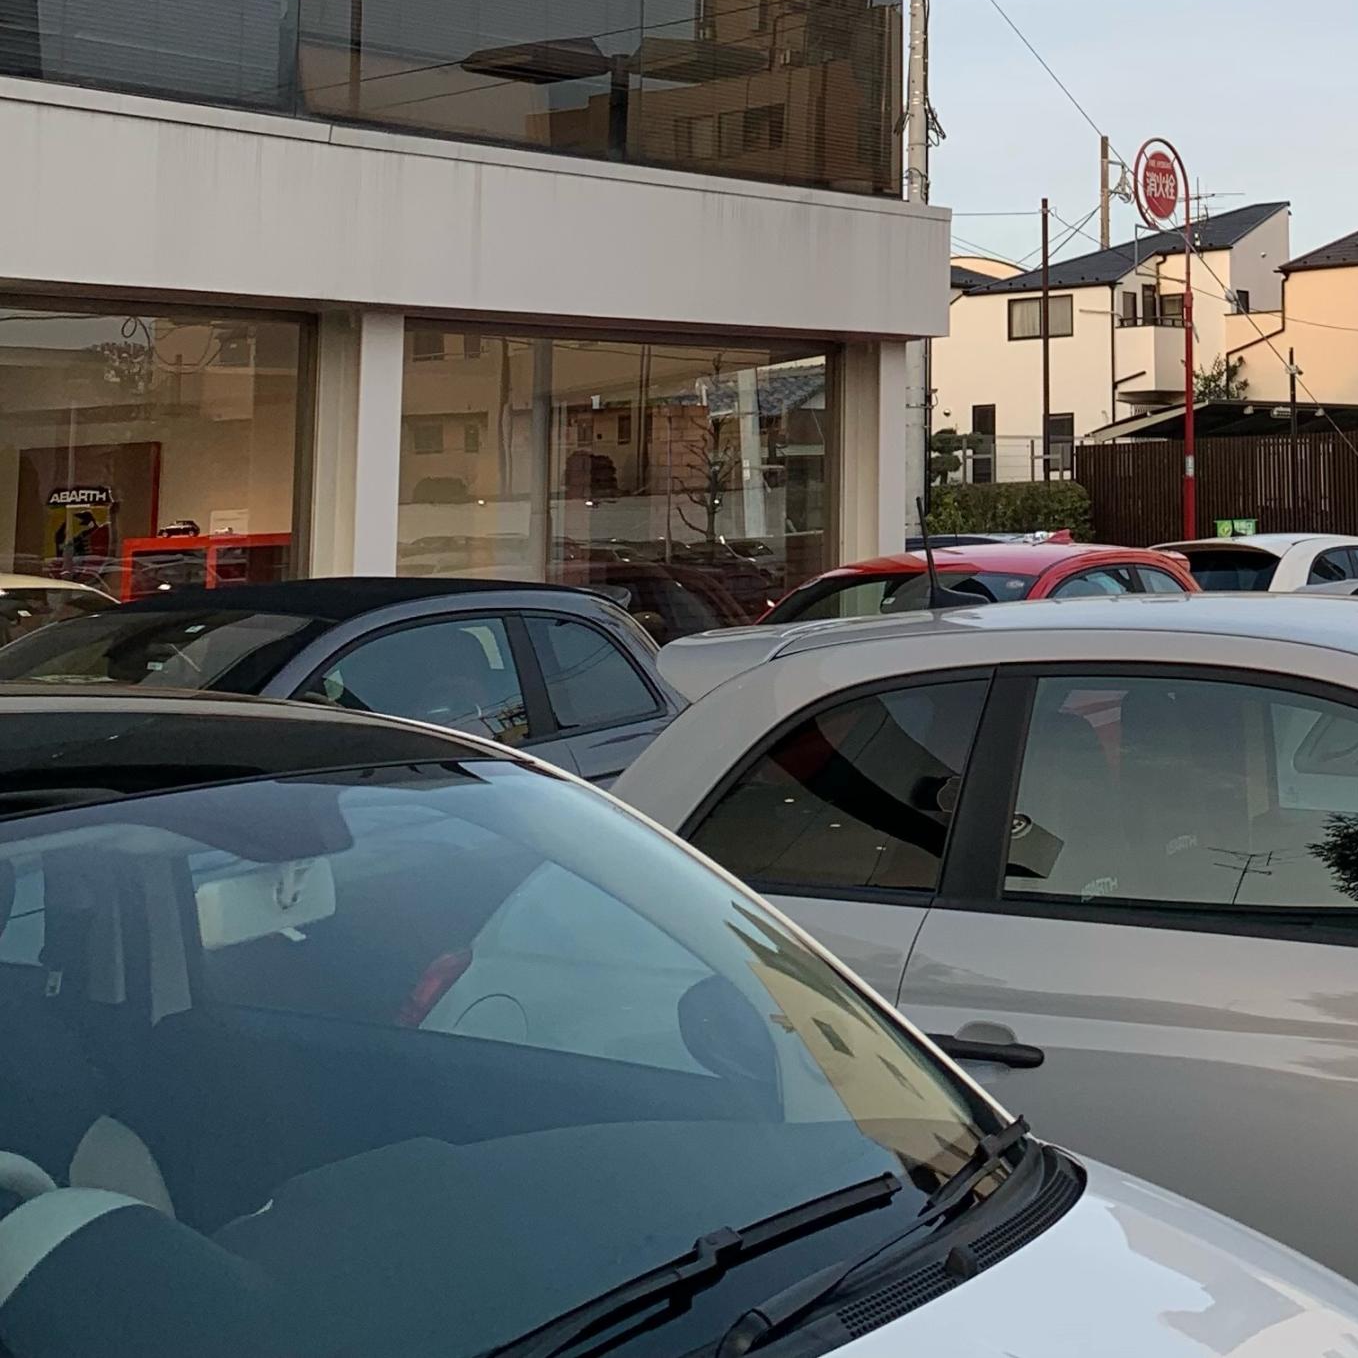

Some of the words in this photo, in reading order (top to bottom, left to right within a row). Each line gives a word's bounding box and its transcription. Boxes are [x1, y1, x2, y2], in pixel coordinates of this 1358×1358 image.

[1146, 171, 1176, 200] 消火栓
[49, 489, 107, 504] ABARTH
